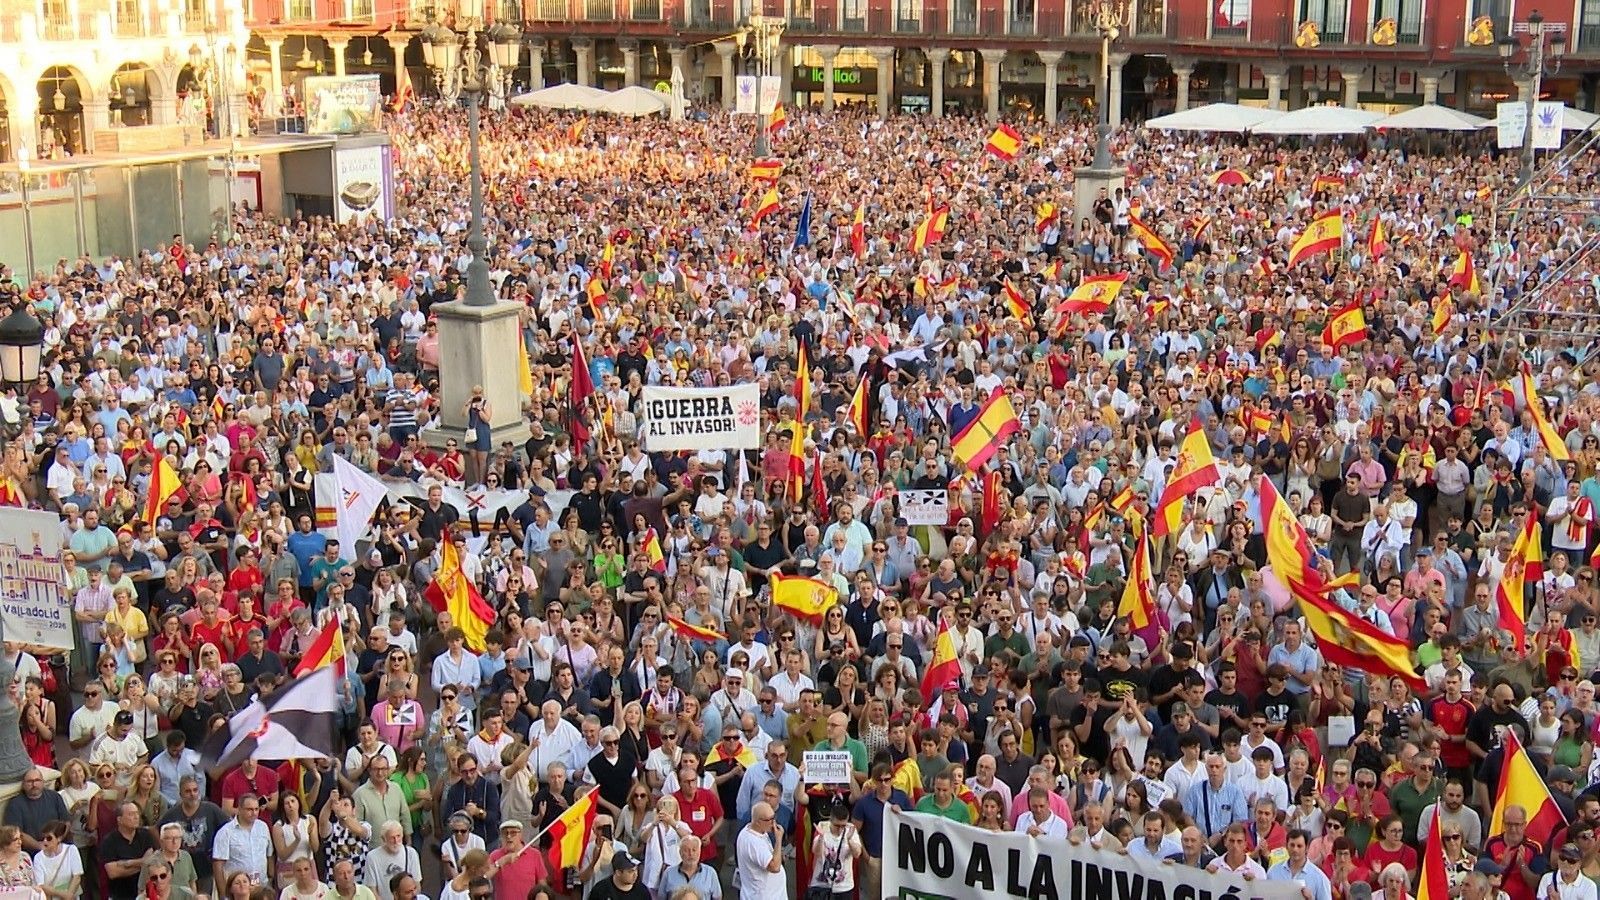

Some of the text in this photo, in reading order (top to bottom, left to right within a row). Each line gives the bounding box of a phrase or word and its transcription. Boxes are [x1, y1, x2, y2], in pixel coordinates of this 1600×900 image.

[649, 418, 737, 436] AL INVASOR!
[898, 822, 955, 879] NO
[964, 841, 995, 892] A
[1007, 848, 1059, 900] LA
